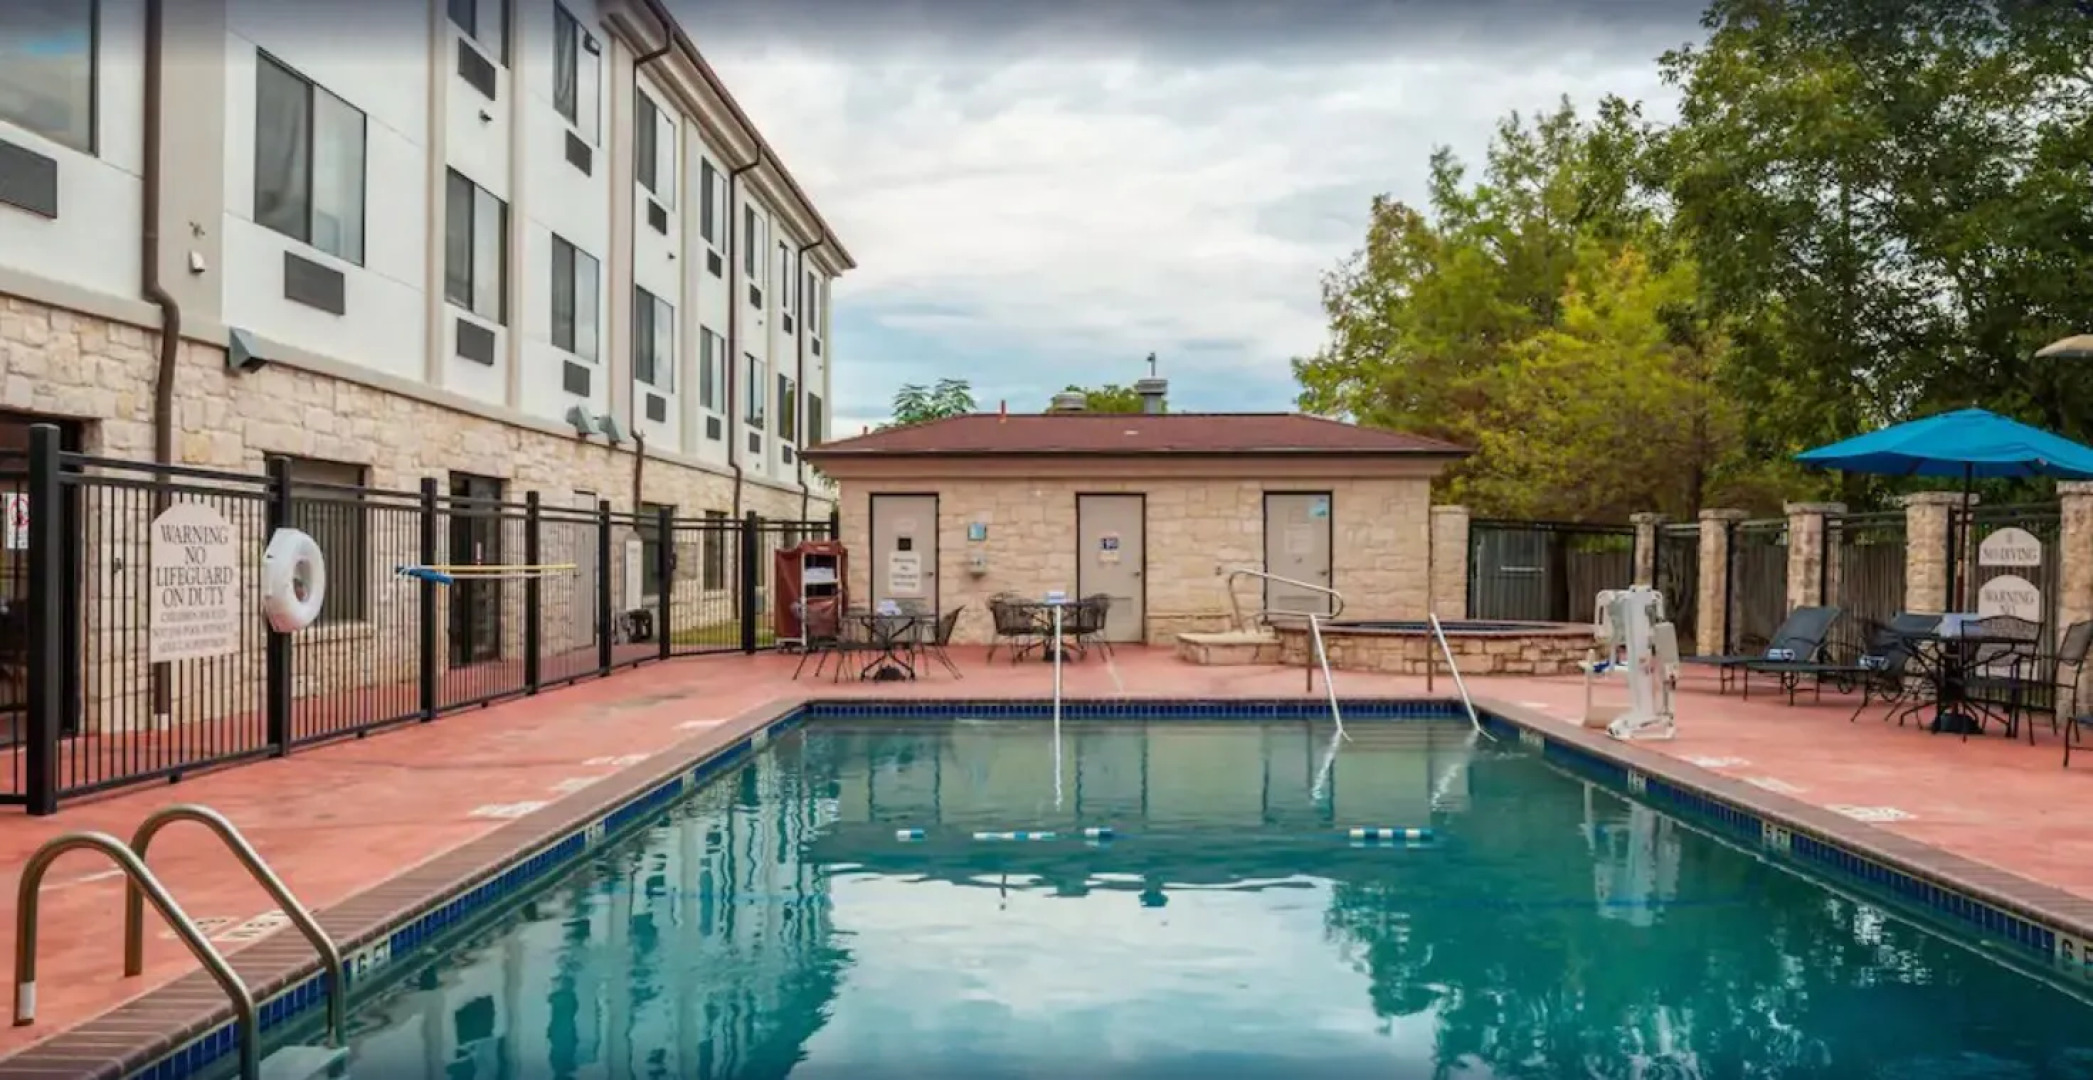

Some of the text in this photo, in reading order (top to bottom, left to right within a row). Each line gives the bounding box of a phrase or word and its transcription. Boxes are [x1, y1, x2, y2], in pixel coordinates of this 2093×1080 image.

[160, 524, 229, 545] WARNING
[184, 545, 206, 564] NO
[156, 566, 234, 586] LIFEGUARD
[162, 585, 226, 608] ON DUTY
